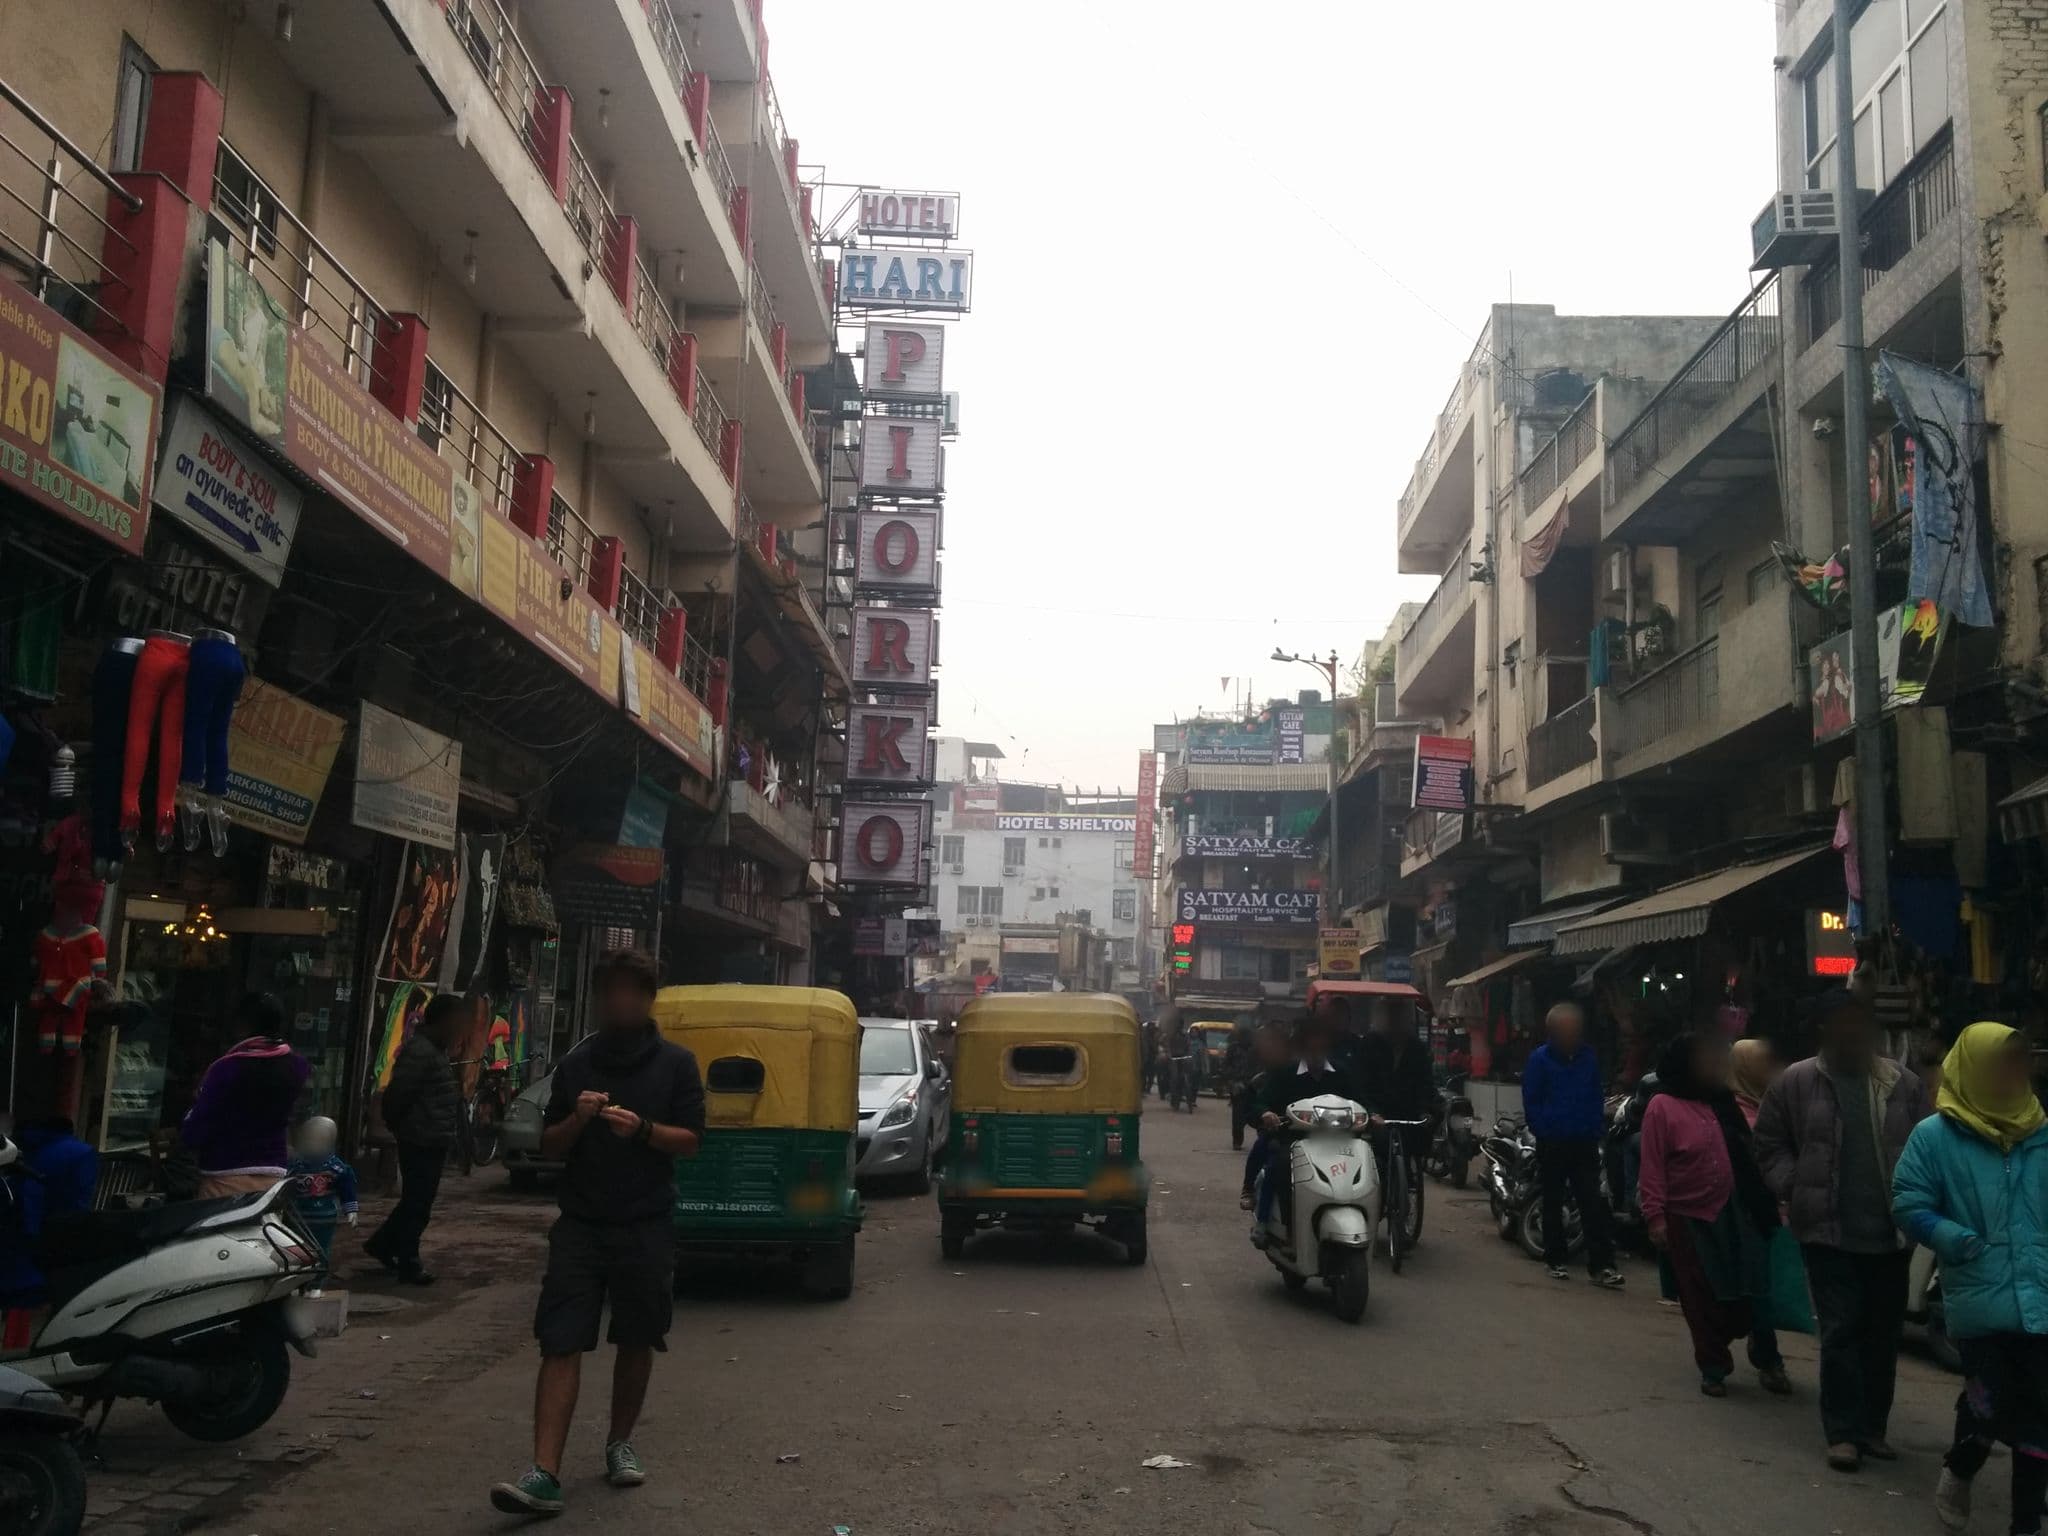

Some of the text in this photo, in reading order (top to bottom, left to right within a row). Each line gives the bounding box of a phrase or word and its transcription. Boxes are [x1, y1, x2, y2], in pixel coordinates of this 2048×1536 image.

[861, 195, 951, 230] HOTEL
[844, 255, 965, 300] HARI
[0, 295, 53, 349] able Price
[0, 352, 50, 446] KO
[289, 344, 361, 449] AYURVEDA
[374, 423, 449, 525] PANCHKARMA
[198, 432, 278, 515] BODY & SOUL
[297, 423, 328, 463] BODY
[332, 456, 339, 474] &
[343, 466, 369, 498] SOUL
[32, 459, 132, 538] HOLIDAYS
[176, 453, 283, 546] an ayurvedic clinic
[518, 539, 552, 609] FIRE
[566, 594, 588, 640] ICE
[1282, 721, 1300, 729] CAFE
[274, 789, 309, 809] SARAF
[276, 805, 306, 824] SHOP
[998, 817, 1136, 832] HOTEL SHELTON
[1186, 837, 1270, 848] SATYAM
[1183, 892, 1268, 907] SATYAM
[1822, 912, 1844, 929] Dr.
[1330, 1162, 1347, 1177] RV
